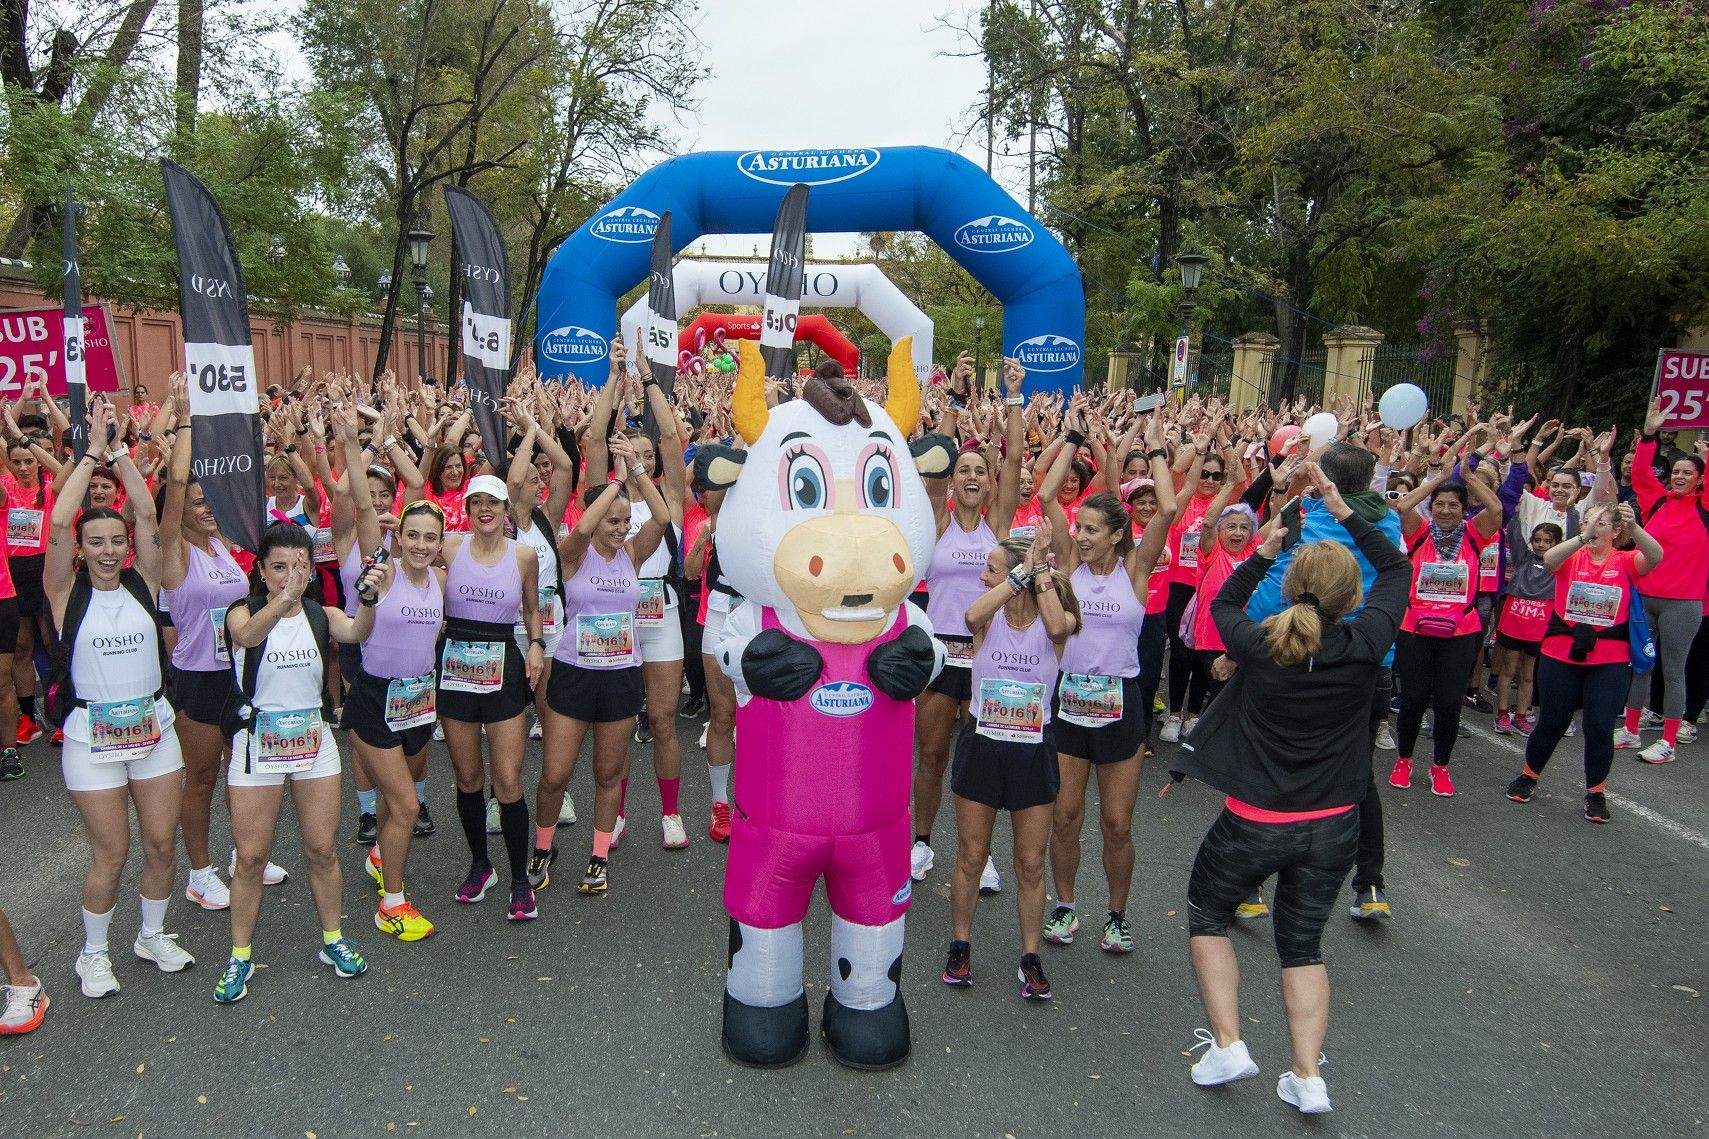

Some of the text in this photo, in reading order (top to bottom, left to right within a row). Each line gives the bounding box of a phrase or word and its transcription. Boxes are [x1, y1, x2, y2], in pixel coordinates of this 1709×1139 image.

[748, 153, 869, 171] ASTURIANA
[961, 230, 1029, 245] ASTURIANA
[719, 271, 838, 296] OYHO
[0, 317, 48, 343] UB
[728, 321, 750, 331] Sports
[85, 338, 108, 347] SHO
[545, 341, 604, 355] ASTURIANA
[1019, 349, 1077, 362] ASTURIANA
[590, 576, 631, 588] OYSHO
[459, 585, 505, 600] OYSHO
[401, 606, 440, 618] OYSHO
[92, 632, 144, 649] OYSHO
[597, 637, 617, 646] 016
[267, 648, 318, 663] OYSHO
[991, 651, 1040, 666] OYSHO
[462, 665, 484, 675] 016
[815, 693, 869, 708] ASTURIANA
[1000, 706, 1024, 718] 016
[113, 725, 142, 738] 016
[280, 737, 305, 748] 016
